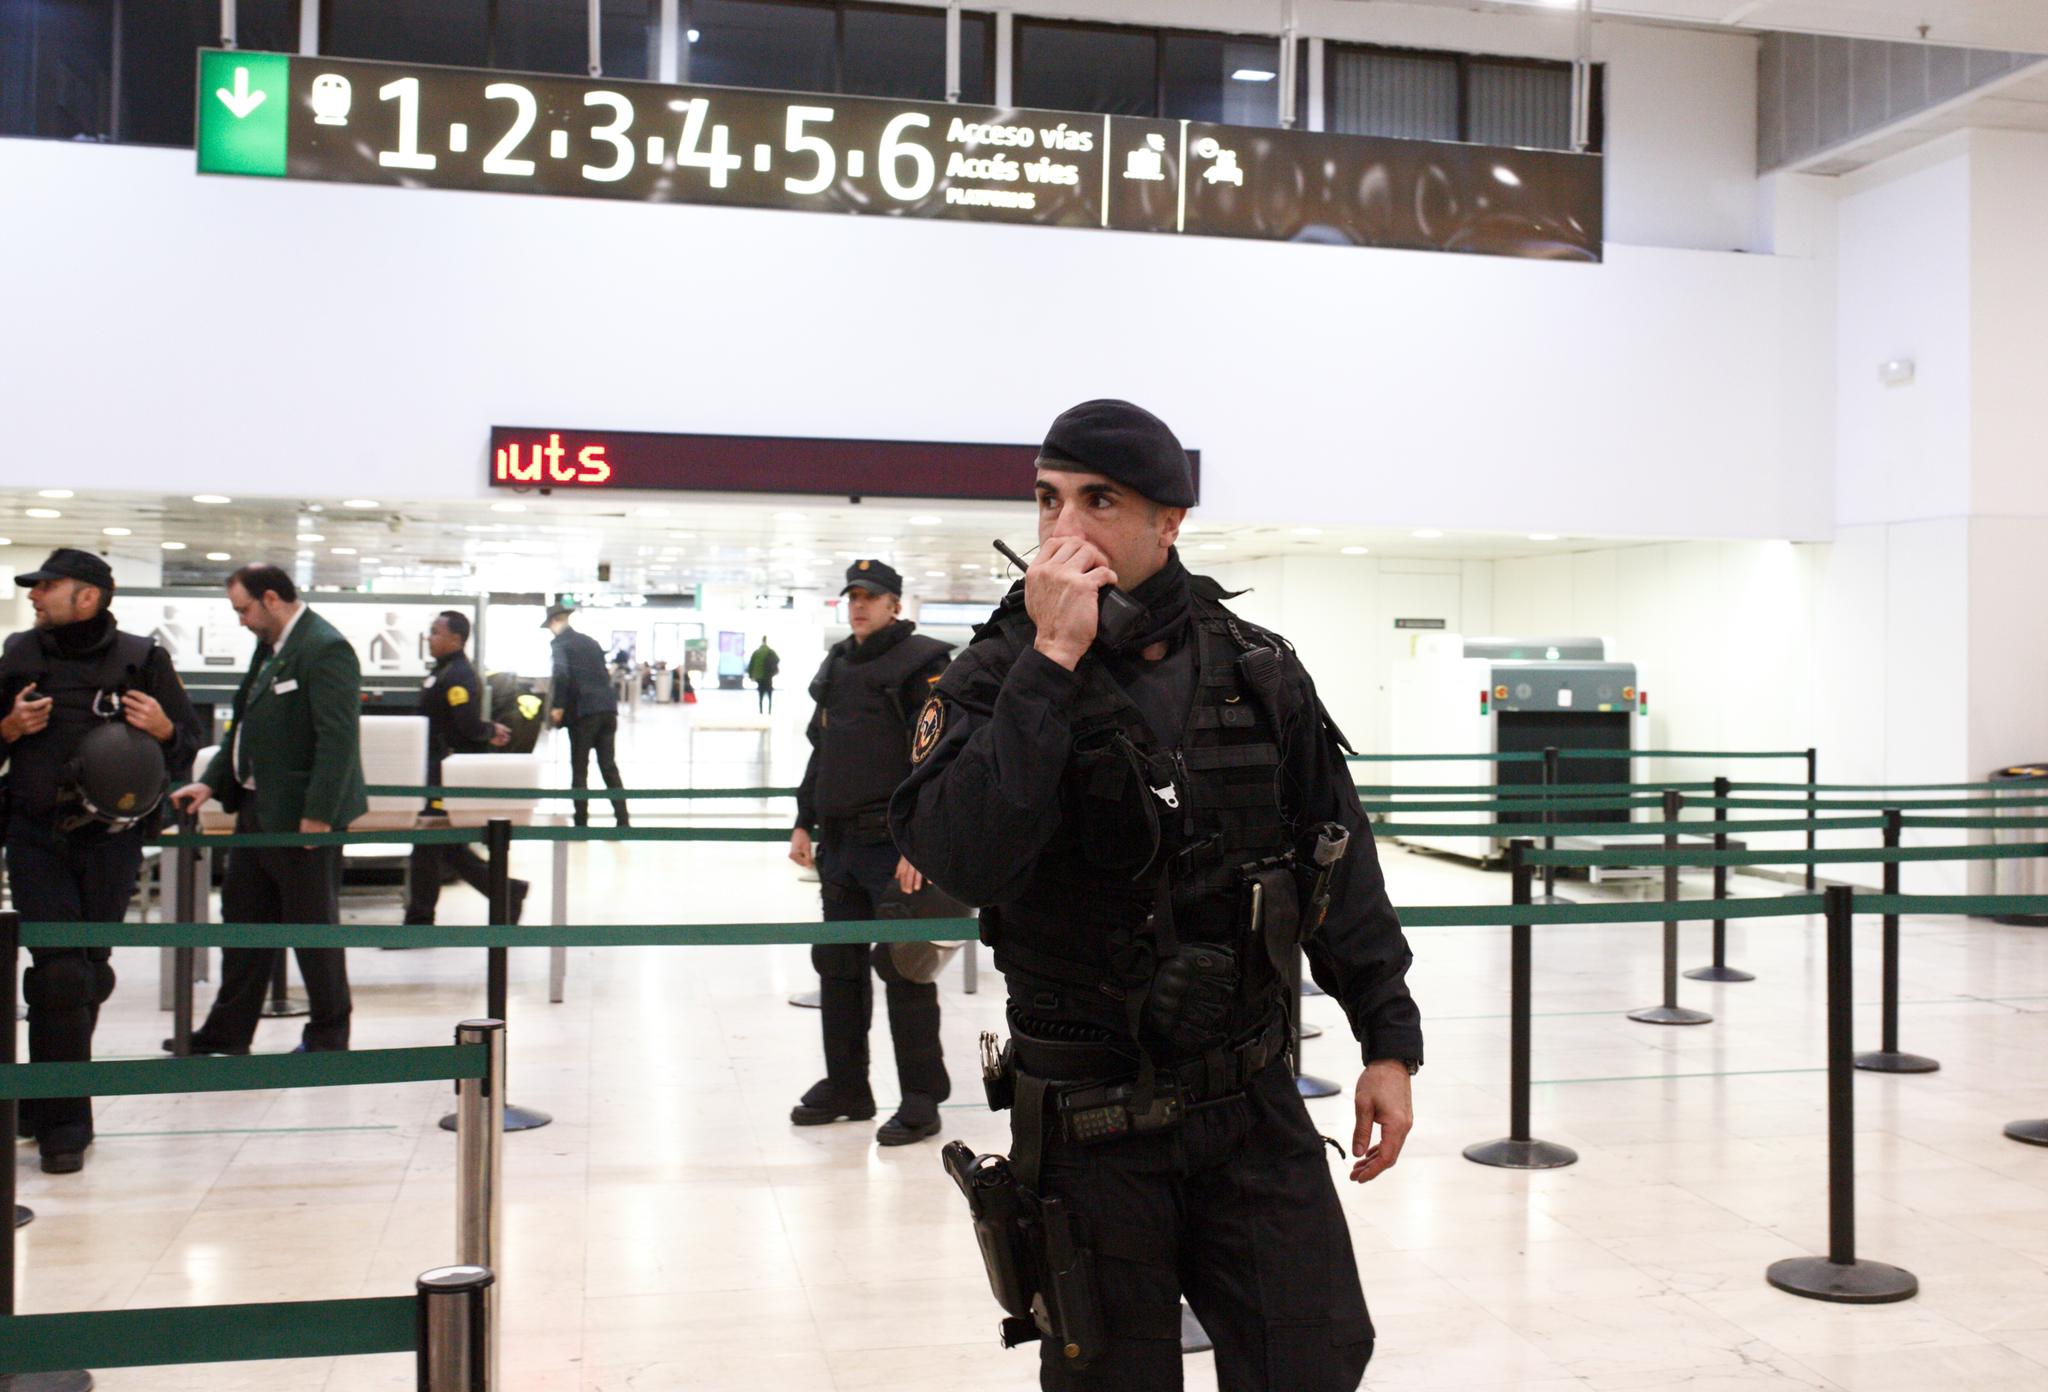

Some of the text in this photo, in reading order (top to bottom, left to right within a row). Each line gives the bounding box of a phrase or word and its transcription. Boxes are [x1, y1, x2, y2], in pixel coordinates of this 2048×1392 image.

[947, 117, 1093, 151] Acceso vías
[946, 152, 1079, 185] Accés vies
